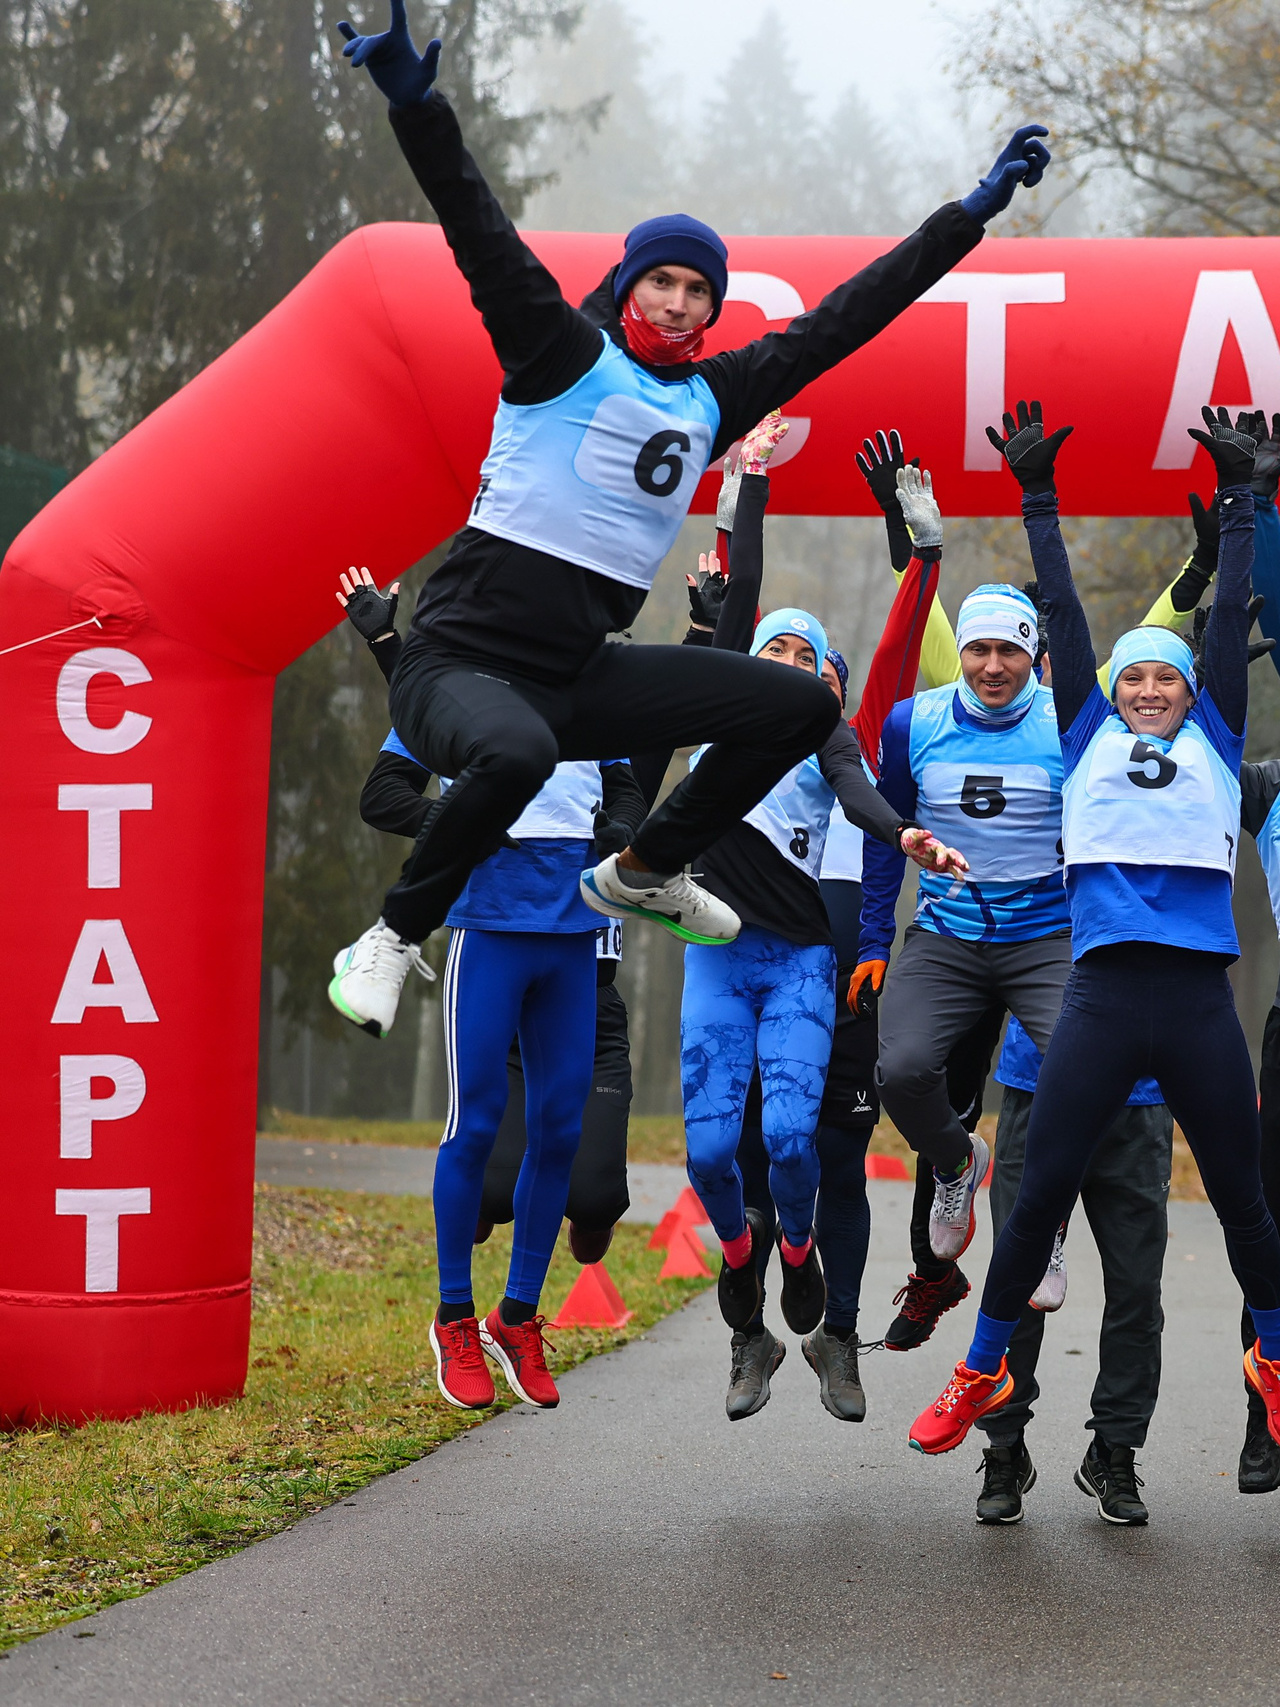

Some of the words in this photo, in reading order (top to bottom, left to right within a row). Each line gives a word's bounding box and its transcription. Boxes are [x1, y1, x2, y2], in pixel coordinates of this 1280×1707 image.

[634, 429, 690, 497] 6
[1127, 740, 1177, 789] 5
[958, 775, 1007, 819] 5
[789, 828, 811, 860] 8
[596, 924, 622, 956] 10
[50, 647, 160, 1293] СТАРТ
